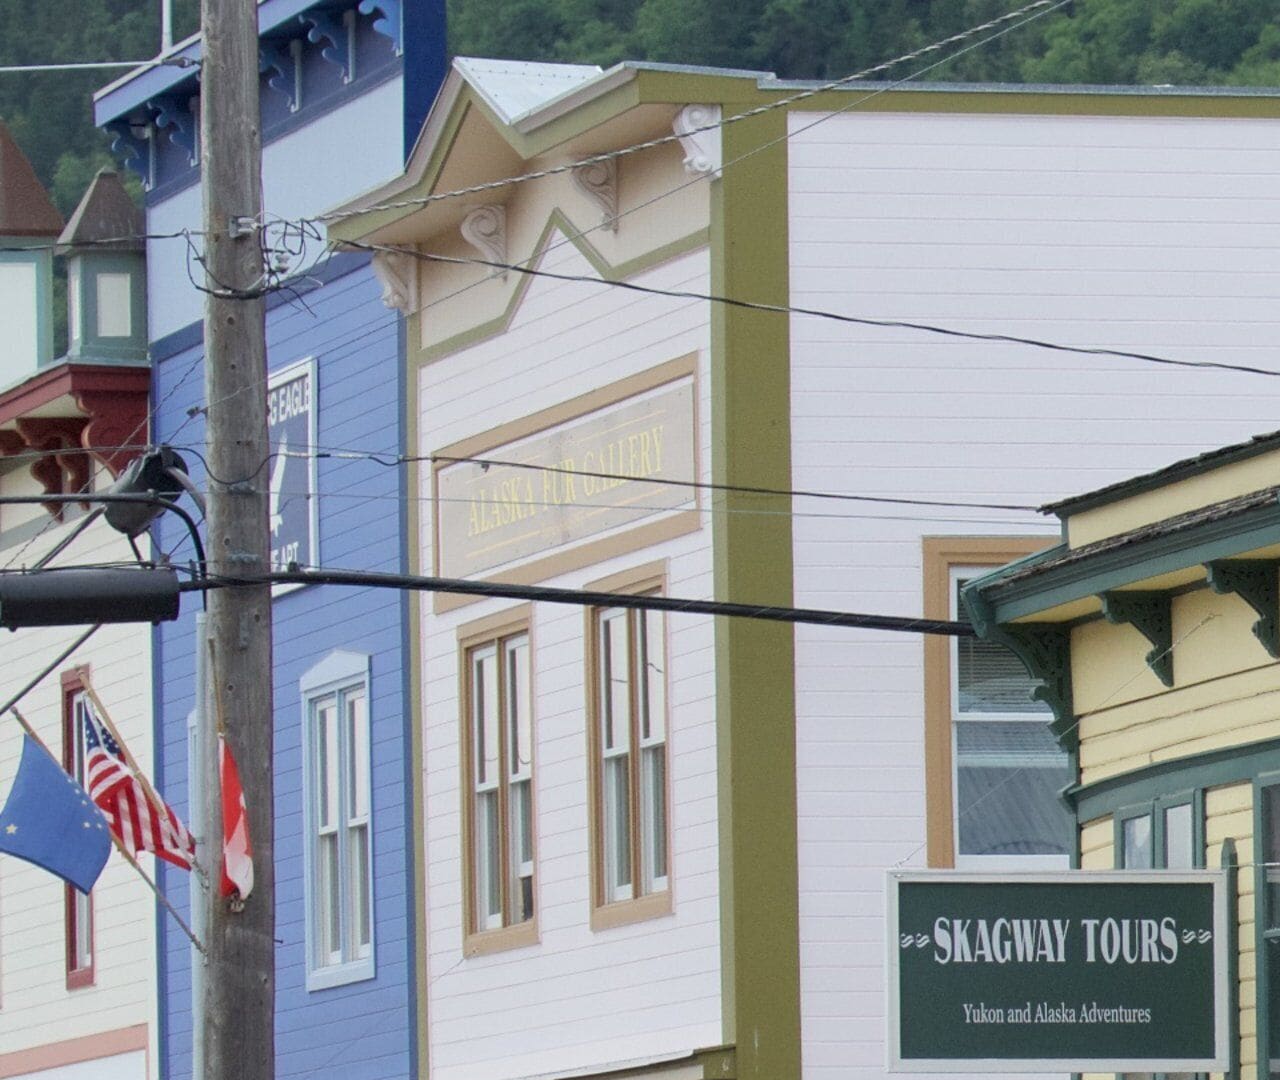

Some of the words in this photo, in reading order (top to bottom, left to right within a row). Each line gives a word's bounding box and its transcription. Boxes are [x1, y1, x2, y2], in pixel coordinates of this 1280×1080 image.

[468, 476, 536, 537] ALASKA
[542, 457, 576, 509] FUR
[582, 425, 665, 497] GALLERY
[934, 917, 1070, 965] SKAGWAY
[1081, 917, 1178, 965] TOURS
[963, 1003, 1004, 1024] Yukon
[1007, 1002, 1032, 1024] and
[1034, 1002, 1076, 1024] Alaska
[1079, 1002, 1151, 1024] Adventures
